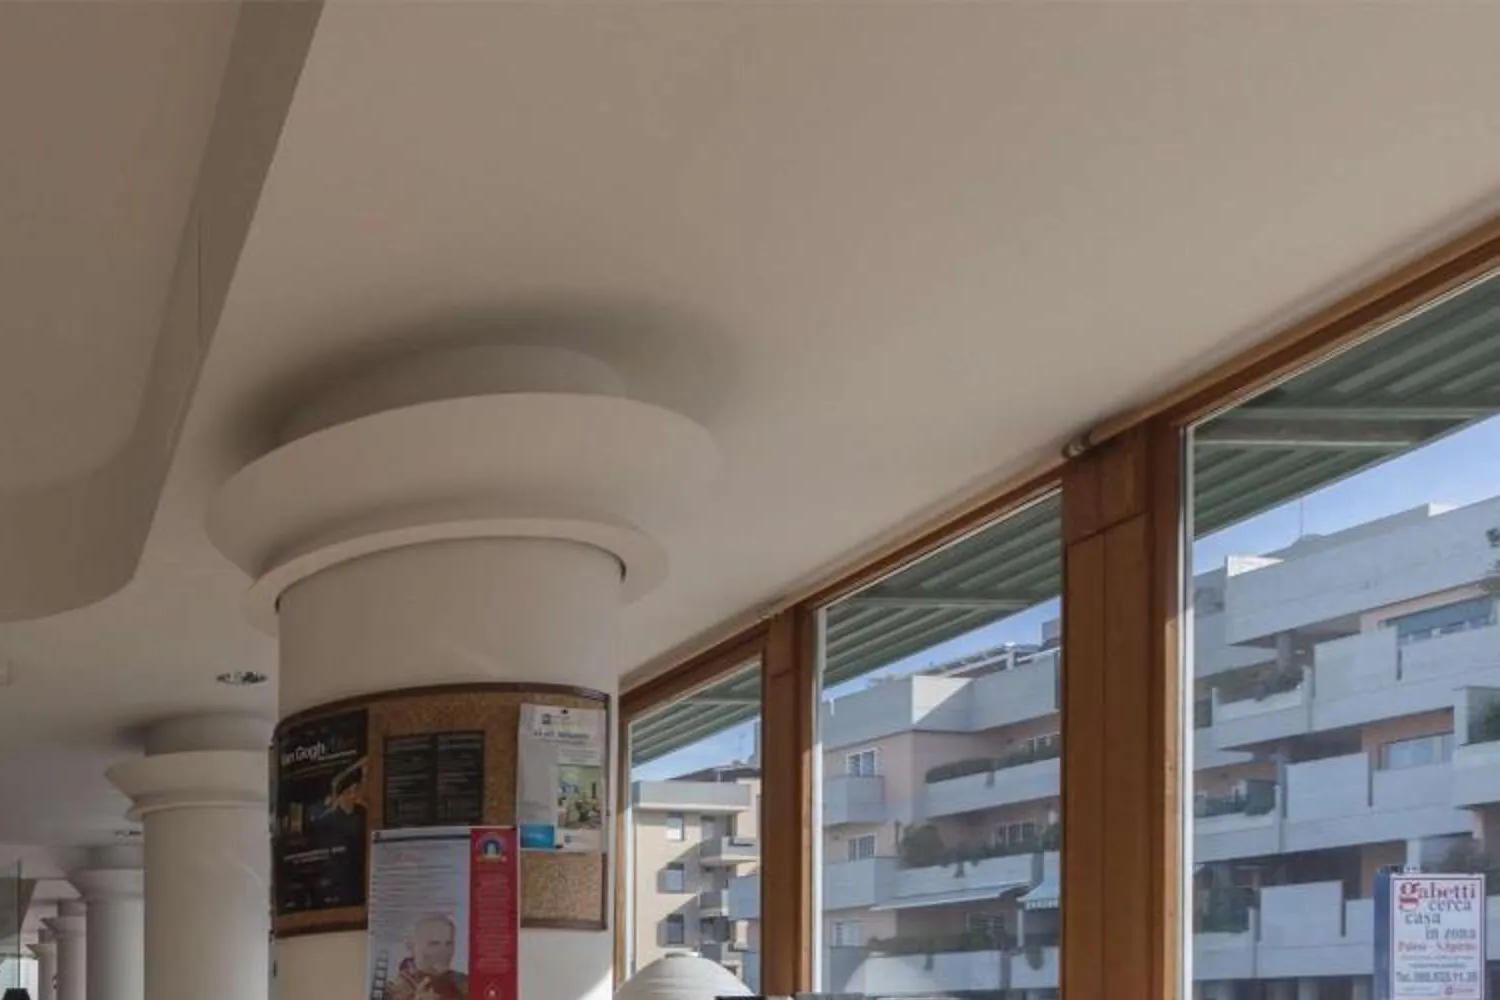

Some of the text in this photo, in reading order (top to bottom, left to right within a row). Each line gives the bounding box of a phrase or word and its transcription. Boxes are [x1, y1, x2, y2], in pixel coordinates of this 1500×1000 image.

[1398, 881, 1477, 912] gabetti
[1427, 899, 1472, 911] cerca
[1405, 912, 1441, 925] casa
[1425, 926, 1477, 940] in zona
